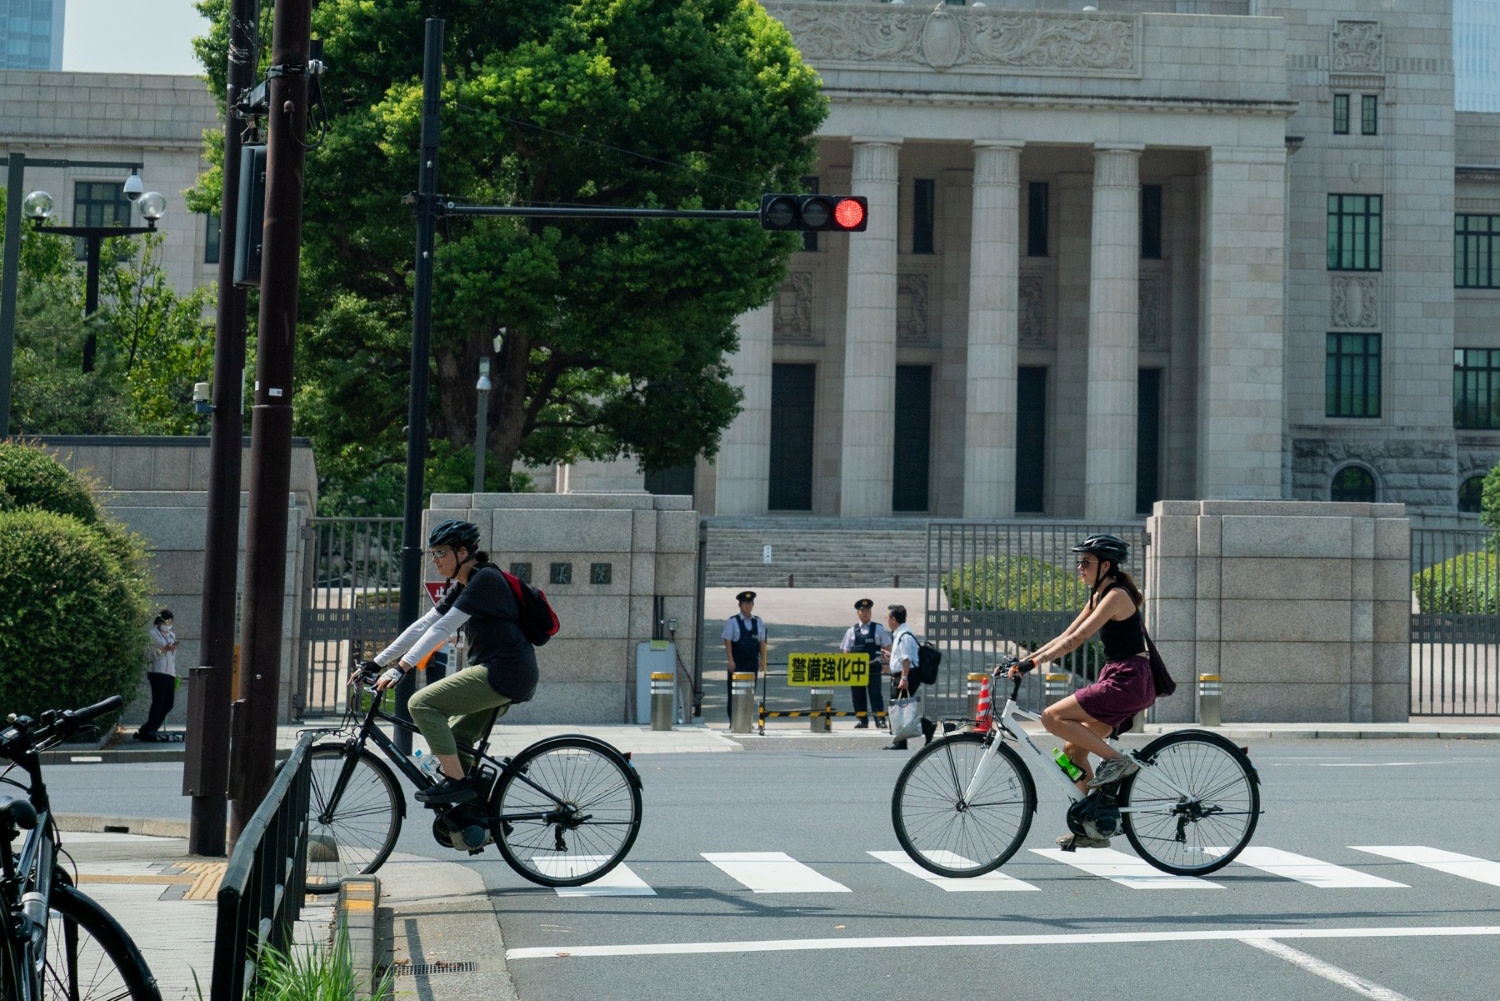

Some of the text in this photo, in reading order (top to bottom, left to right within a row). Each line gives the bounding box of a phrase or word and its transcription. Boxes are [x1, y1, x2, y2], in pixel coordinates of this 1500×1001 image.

[792, 657, 867, 682] 警備強化中
